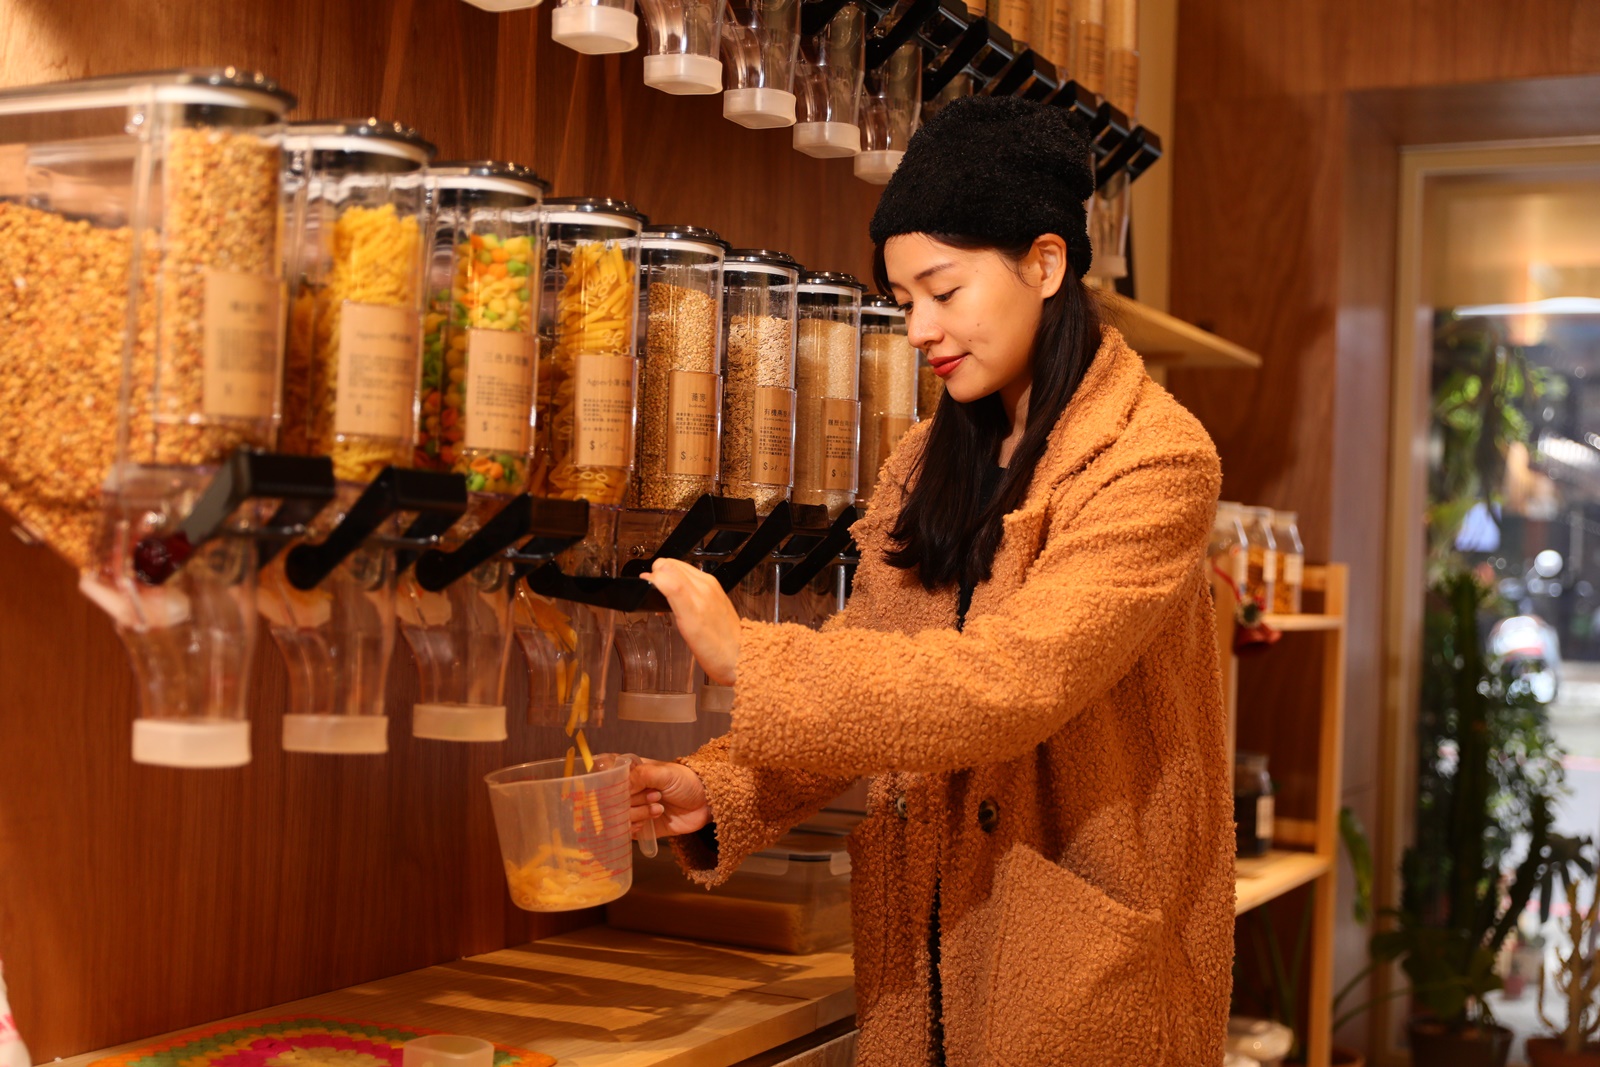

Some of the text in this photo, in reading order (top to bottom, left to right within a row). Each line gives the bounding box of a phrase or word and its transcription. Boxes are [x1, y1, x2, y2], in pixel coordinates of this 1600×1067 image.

[680, 450, 687, 461] $
[763, 461, 769, 471] $
[831, 468, 837, 478] $
